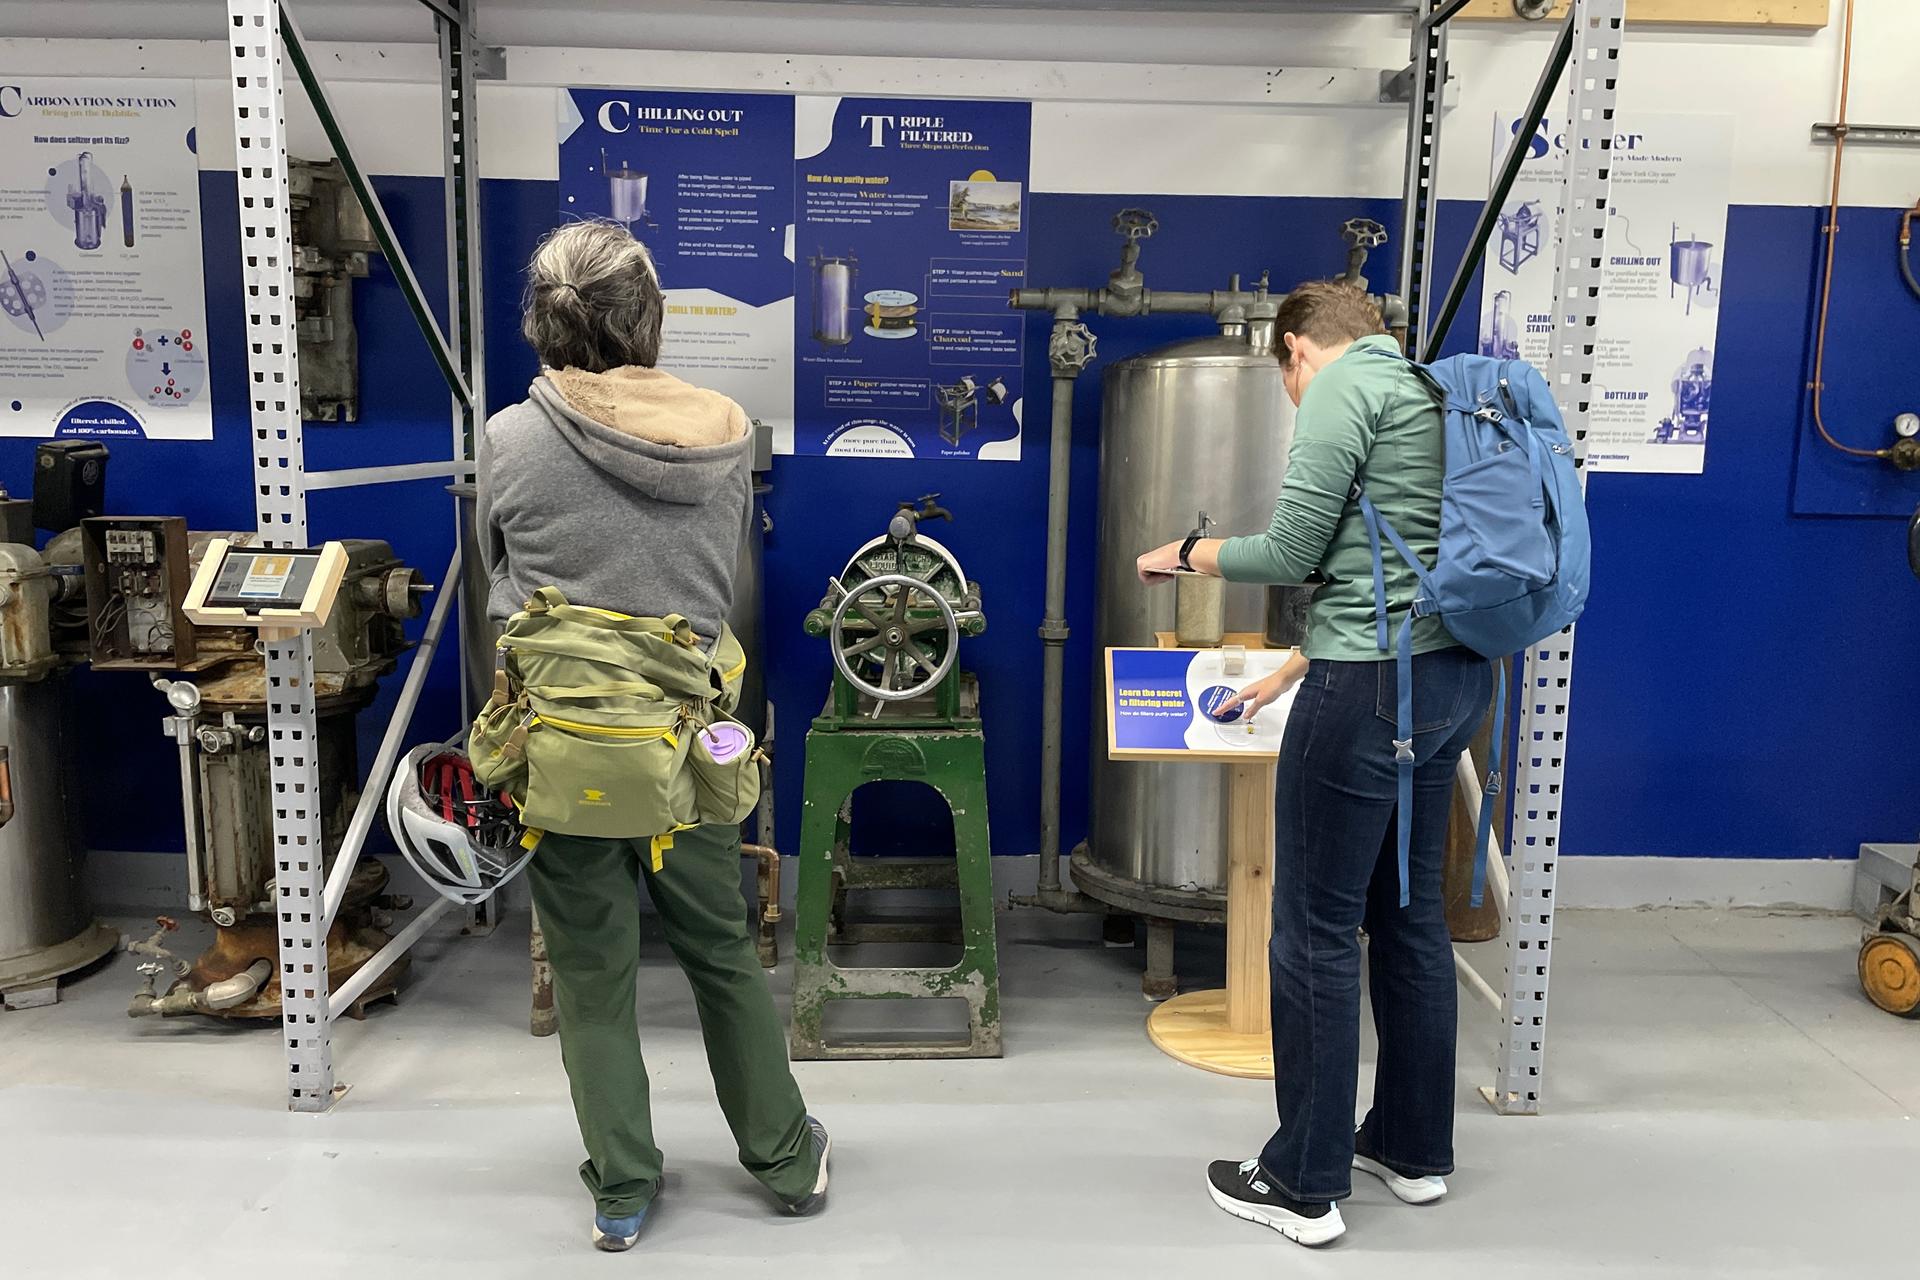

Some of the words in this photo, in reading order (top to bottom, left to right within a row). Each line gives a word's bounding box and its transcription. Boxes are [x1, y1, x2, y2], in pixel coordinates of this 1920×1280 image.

[117, 98, 176, 108] STATION
[708, 109, 743, 122] OUT
[715, 128, 739, 136] Spell
[900, 130, 973, 143] FILTERED
[823, 175, 832, 183] do
[844, 175, 864, 184] purify
[865, 176, 889, 184] water?
[1610, 256, 1644, 265] CHILLING
[1646, 257, 1661, 265] OUT
[667, 305, 688, 314] CHILL
[690, 306, 704, 315] THE
[705, 307, 737, 316] WATER?
[1129, 699, 1161, 707] filtering
